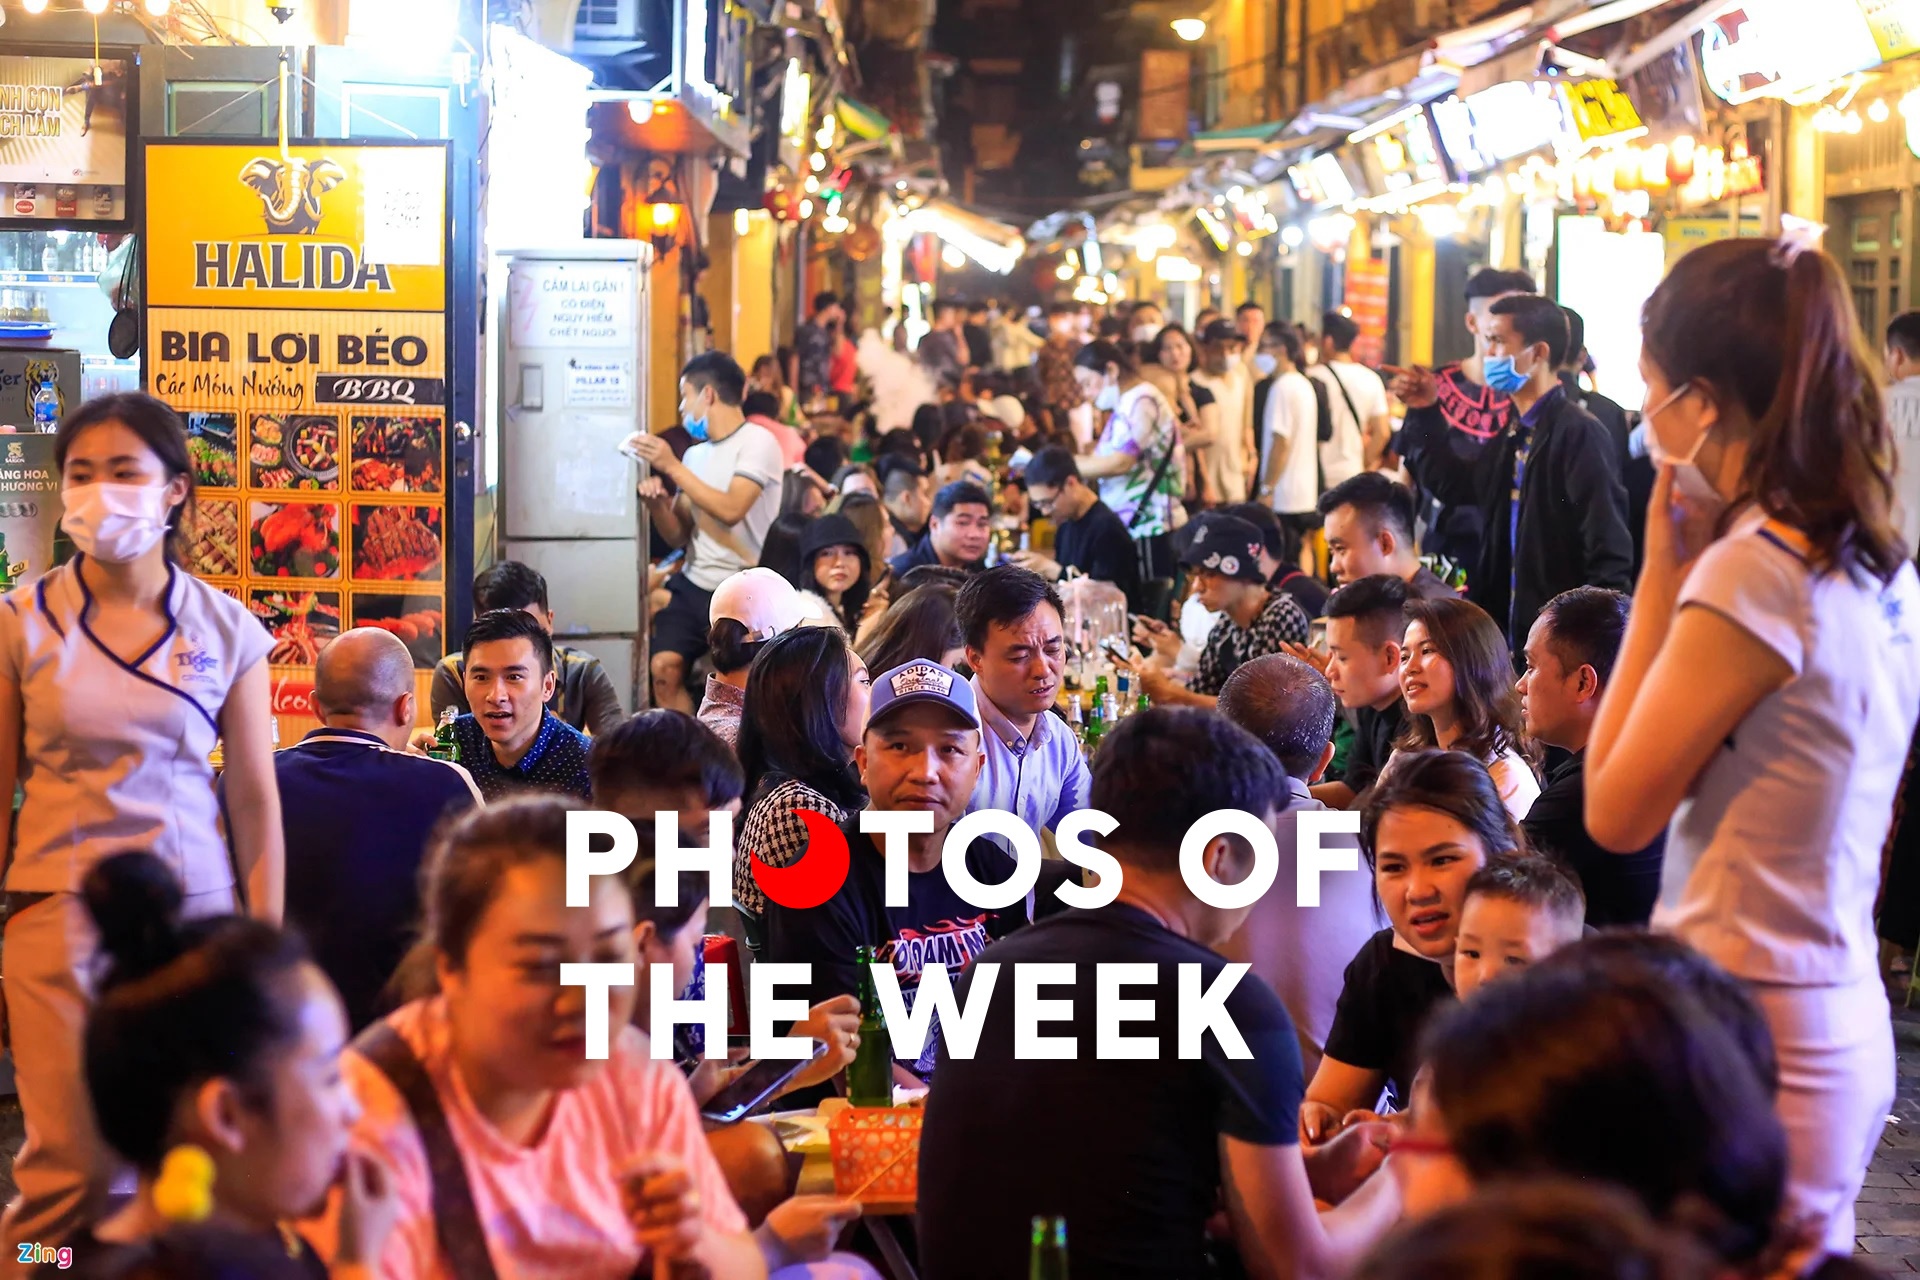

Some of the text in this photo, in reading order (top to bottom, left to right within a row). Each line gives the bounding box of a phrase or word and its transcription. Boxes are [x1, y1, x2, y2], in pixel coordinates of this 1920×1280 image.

[26, 86, 60, 116] GỌN
[26, 109, 60, 137] LÀM
[193, 242, 393, 291] HALIDA
[161, 330, 230, 362] BIA
[337, 327, 428, 366] BÉO
[156, 370, 304, 410] Các Món Nướng
[333, 378, 416, 405] BBQ
[24, 469, 49, 480] HOA
[899, 666, 944, 678] ADIDAS
